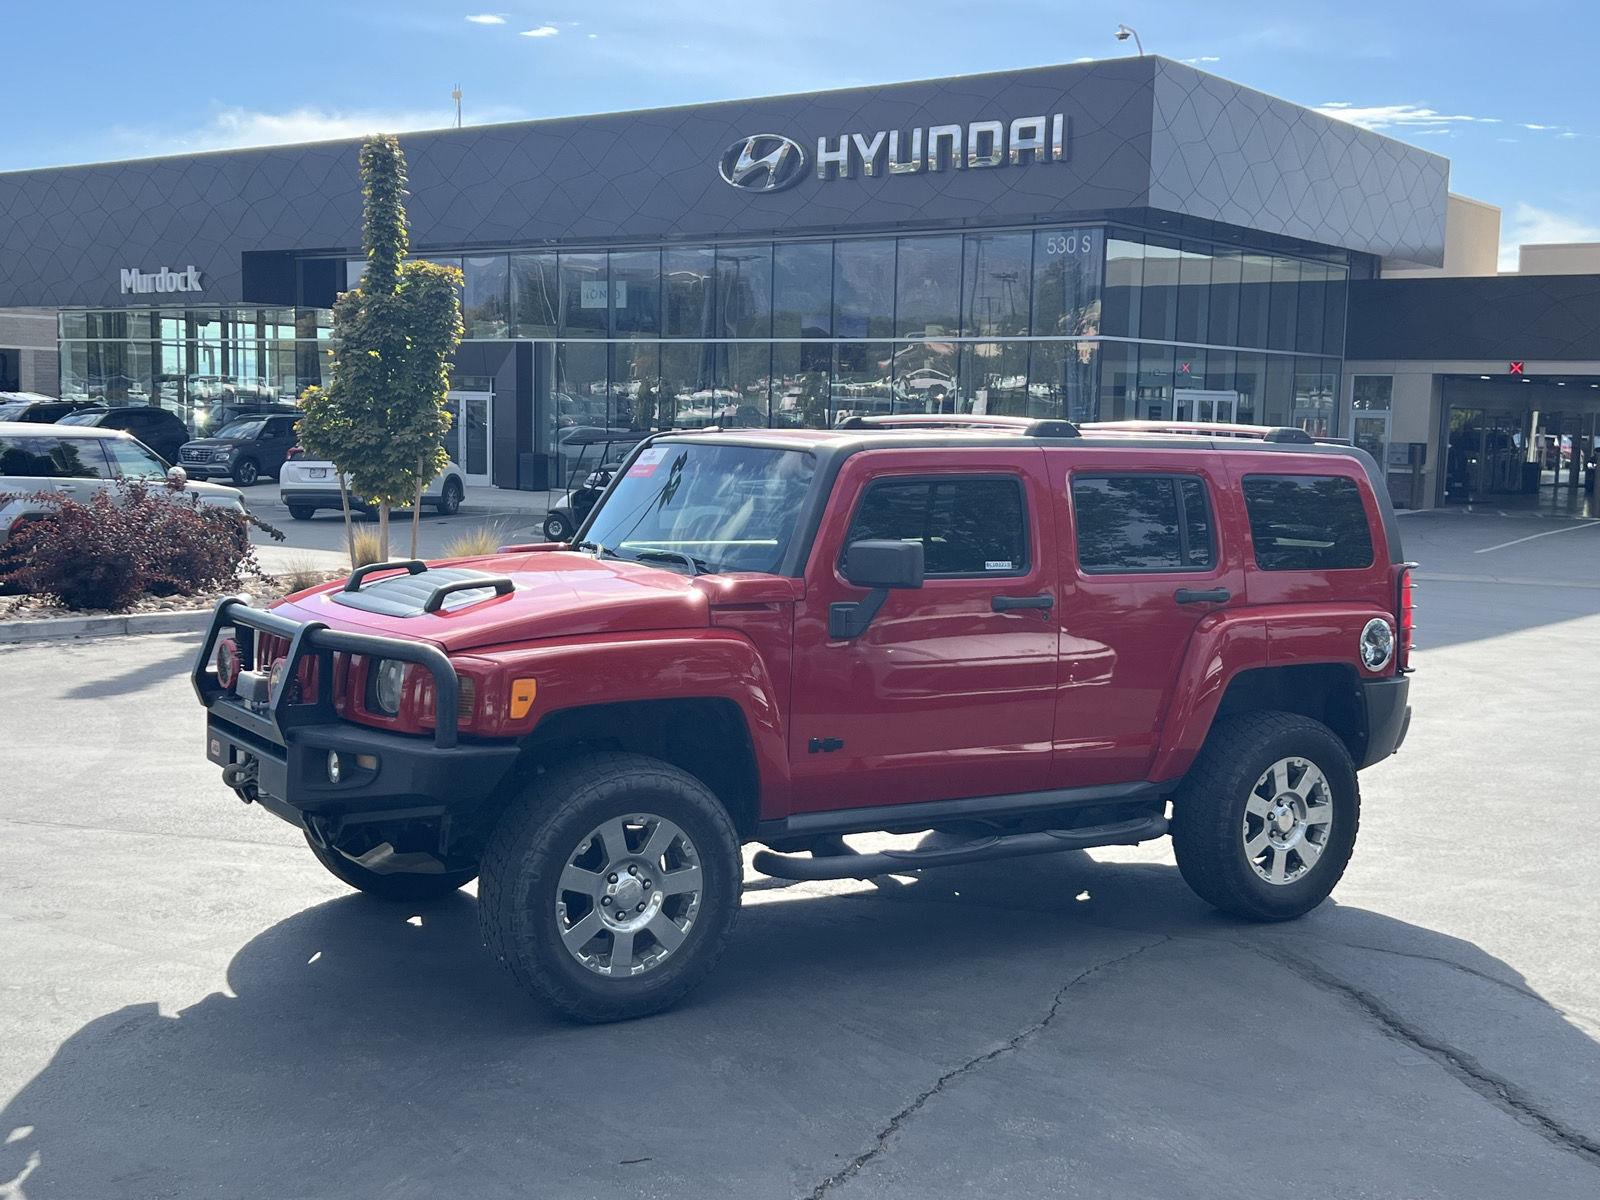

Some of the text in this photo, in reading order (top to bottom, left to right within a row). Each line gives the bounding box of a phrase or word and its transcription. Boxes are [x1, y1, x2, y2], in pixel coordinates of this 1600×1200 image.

[816, 113, 1067, 181] HYUNDAI
[1047, 235, 1091, 255] 530 S
[120, 265, 204, 294] Murdock
